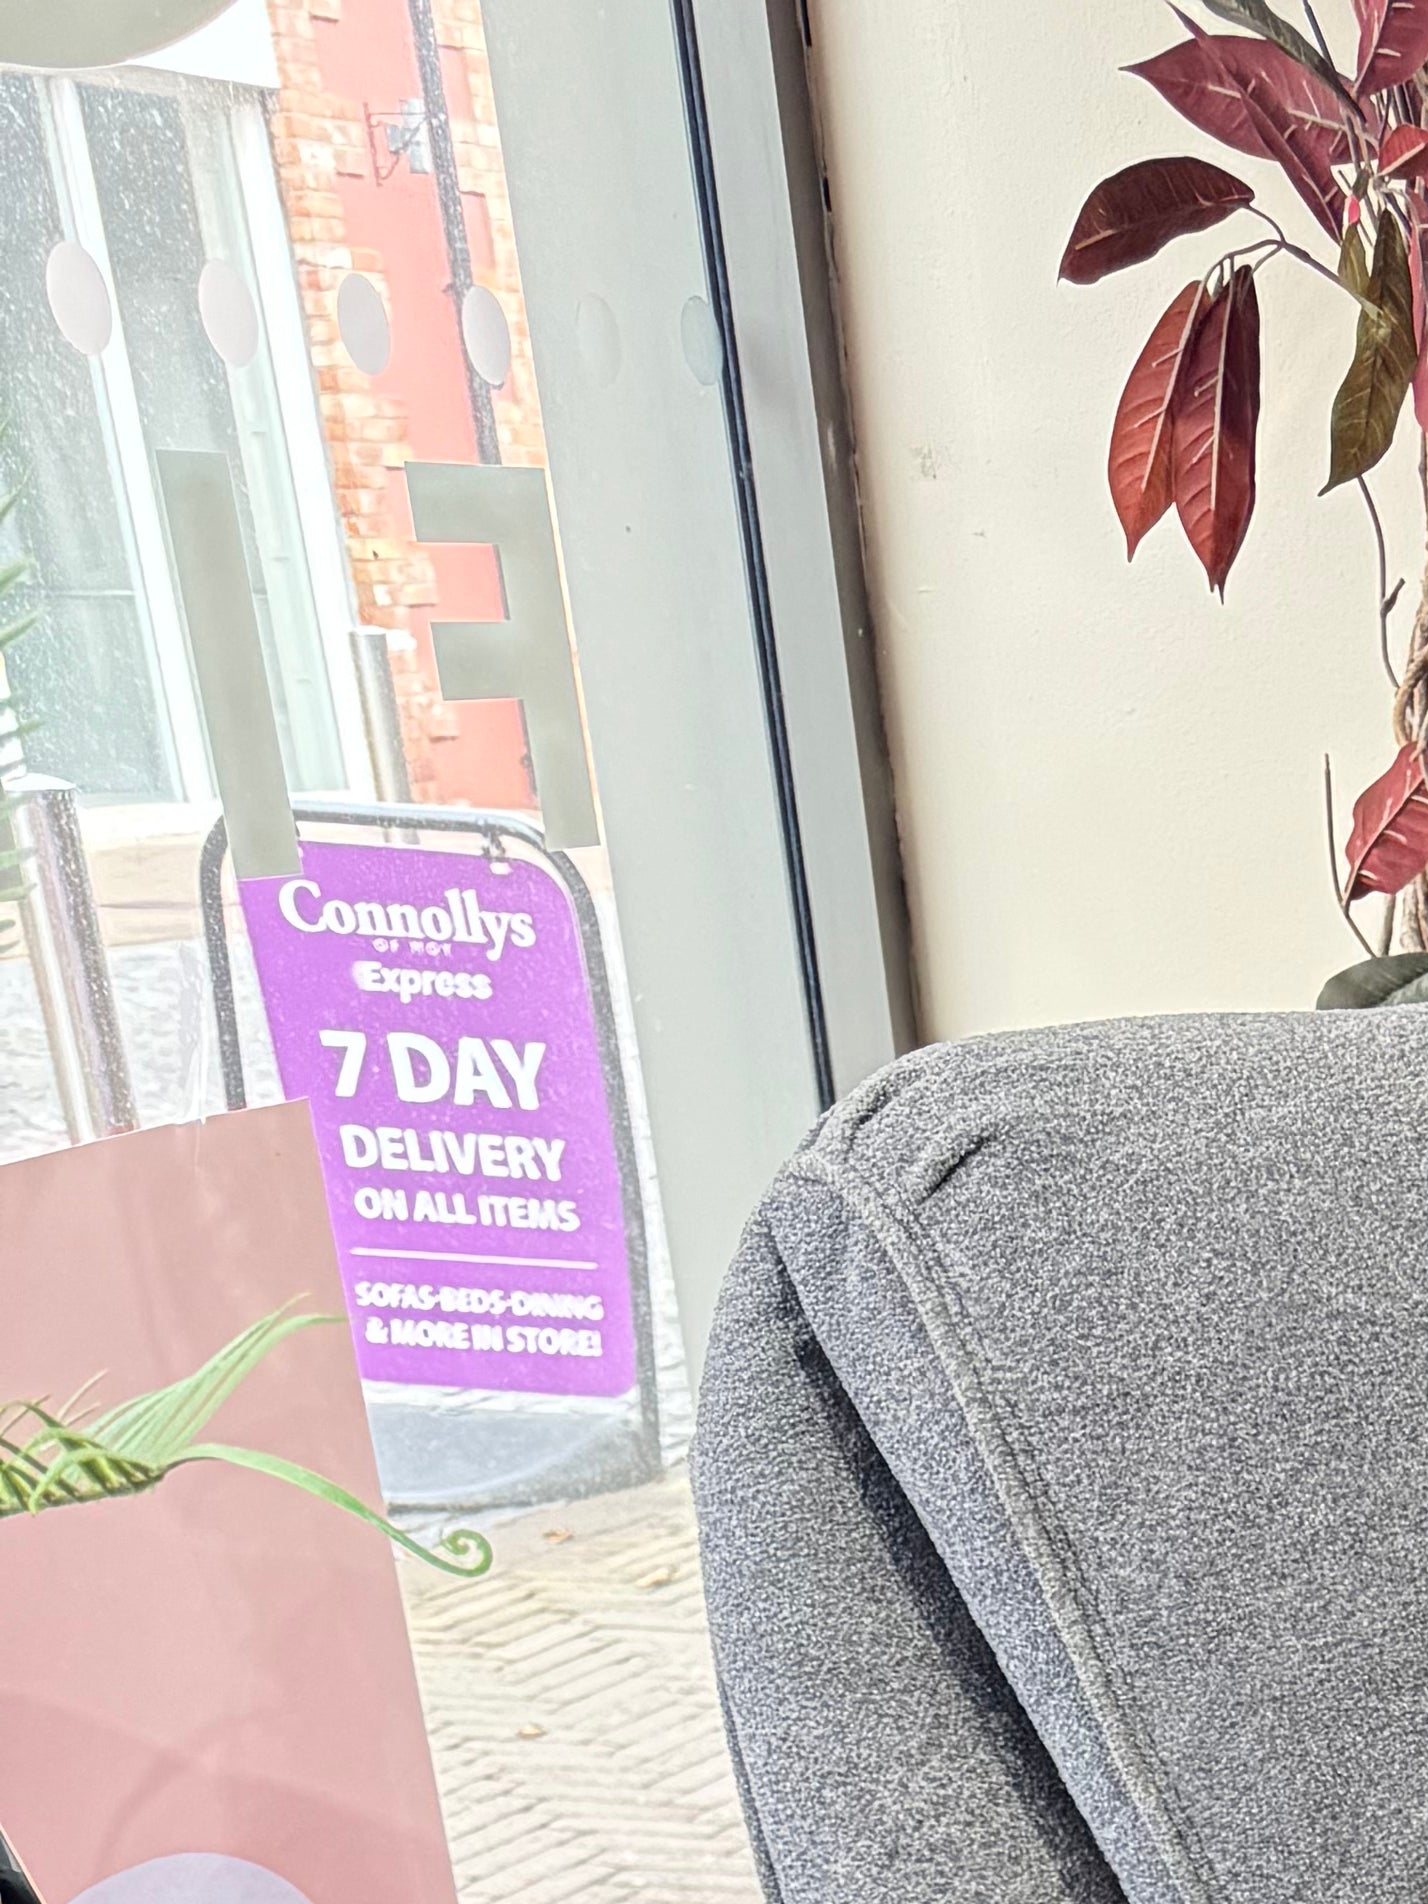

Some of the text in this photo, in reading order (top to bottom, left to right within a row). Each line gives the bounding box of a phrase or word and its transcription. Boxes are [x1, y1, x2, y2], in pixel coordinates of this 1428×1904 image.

[278, 878, 537, 961] Connollys
[353, 961, 492, 1004] Express
[318, 1029, 547, 1111] 7 DAY
[339, 1124, 566, 1182] DELIVERY
[353, 1186, 580, 1233] ON ALL ITEMS
[365, 1317, 388, 1344] &
[390, 1318, 471, 1350] MORE
[471, 1321, 504, 1352] IN
